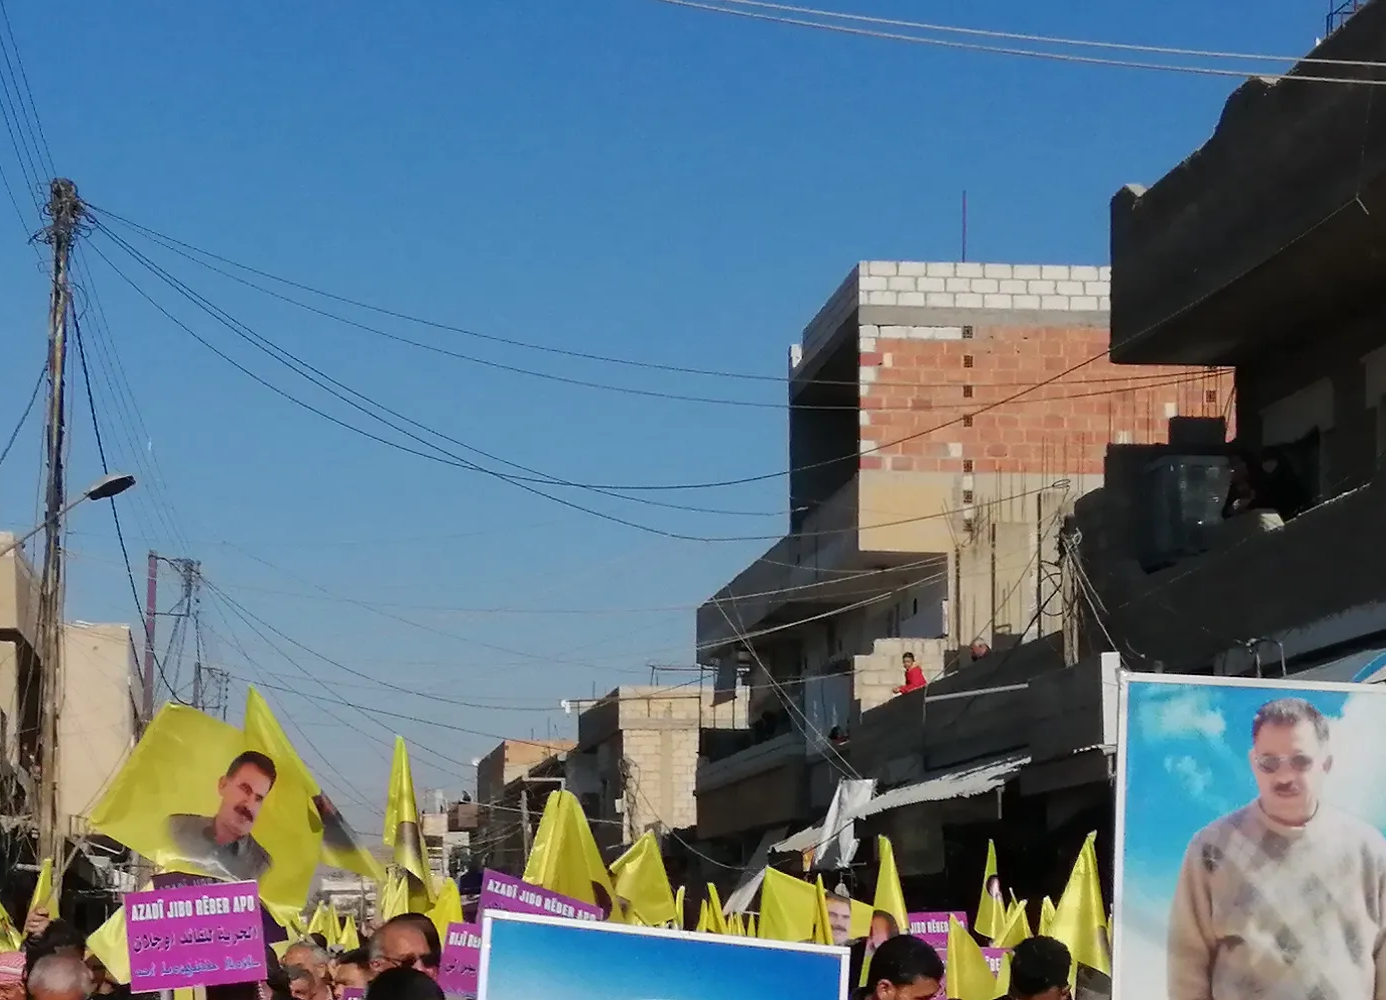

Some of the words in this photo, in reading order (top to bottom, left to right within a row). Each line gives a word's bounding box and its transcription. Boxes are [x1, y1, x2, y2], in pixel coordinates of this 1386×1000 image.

[486, 879, 518, 899] AZADÎ
[131, 899, 164, 922] AZADÎ
[167, 900, 193, 918] JIBO
[196, 895, 229, 916] RÊBER
[233, 895, 255, 913] APO
